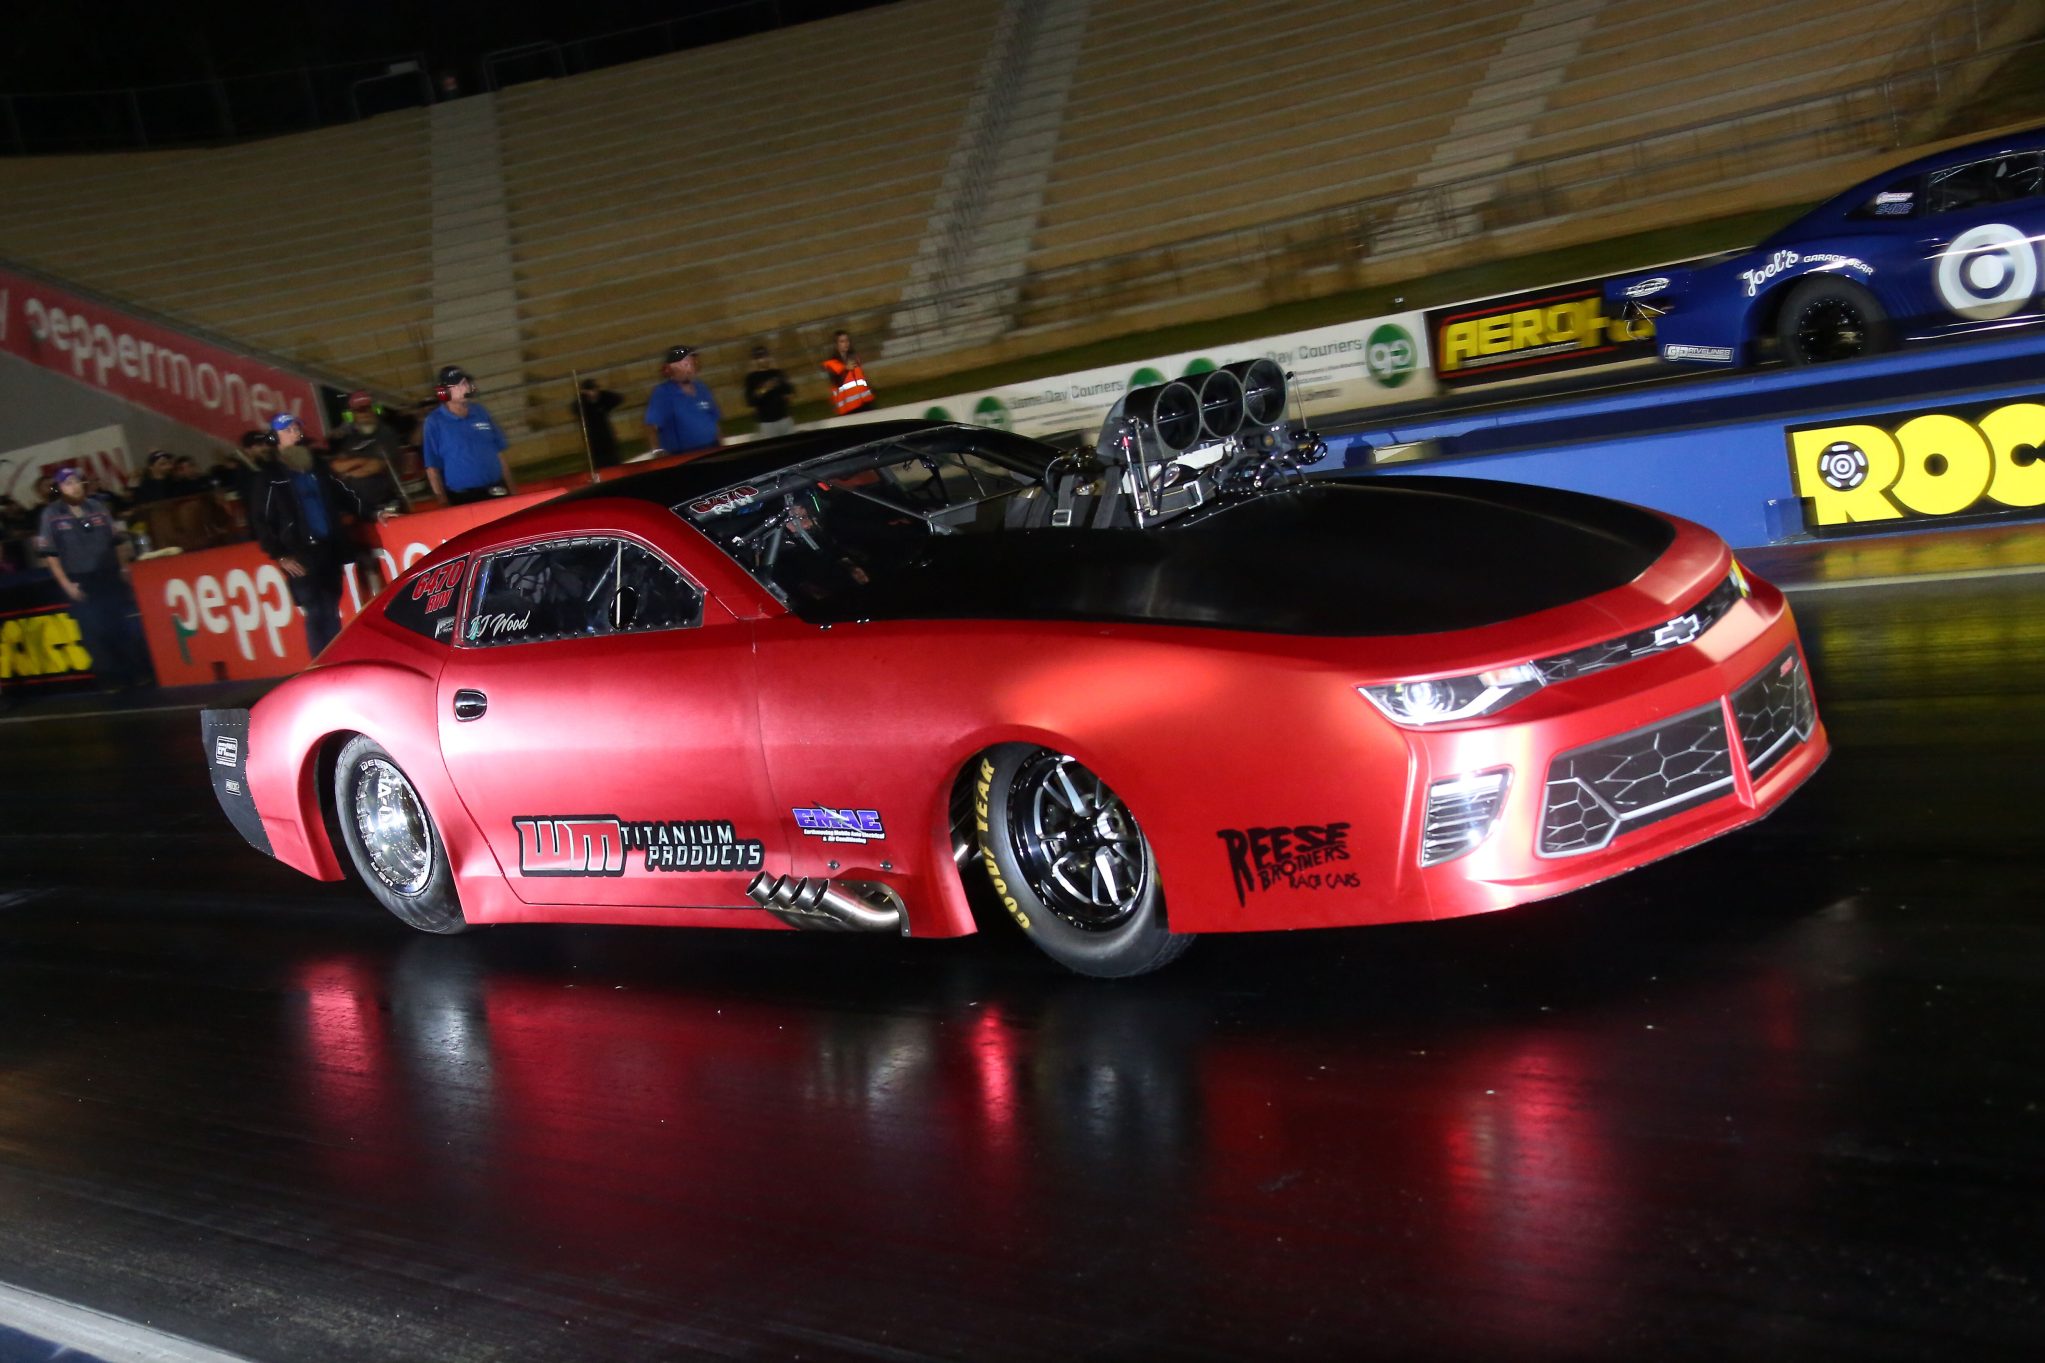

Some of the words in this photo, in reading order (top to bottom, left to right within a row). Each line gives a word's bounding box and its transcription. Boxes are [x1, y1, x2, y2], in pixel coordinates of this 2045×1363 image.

[1742, 250, 1799, 297] Joel's
[1803, 253, 1847, 263] GARAGE
[1847, 257, 1874, 275] GEAR
[1298, 337, 1363, 359] Couriers
[1044, 389, 1068, 402] Day
[1071, 380, 1125, 398] Couriers
[411, 559, 466, 601] 6470
[490, 610, 531, 637] Wood
[620, 824, 734, 846] TITANIUM
[647, 844, 761, 867] PRODUCTS
[1216, 822, 1352, 908] REESE
[1257, 844, 1351, 892] BROTHERS
